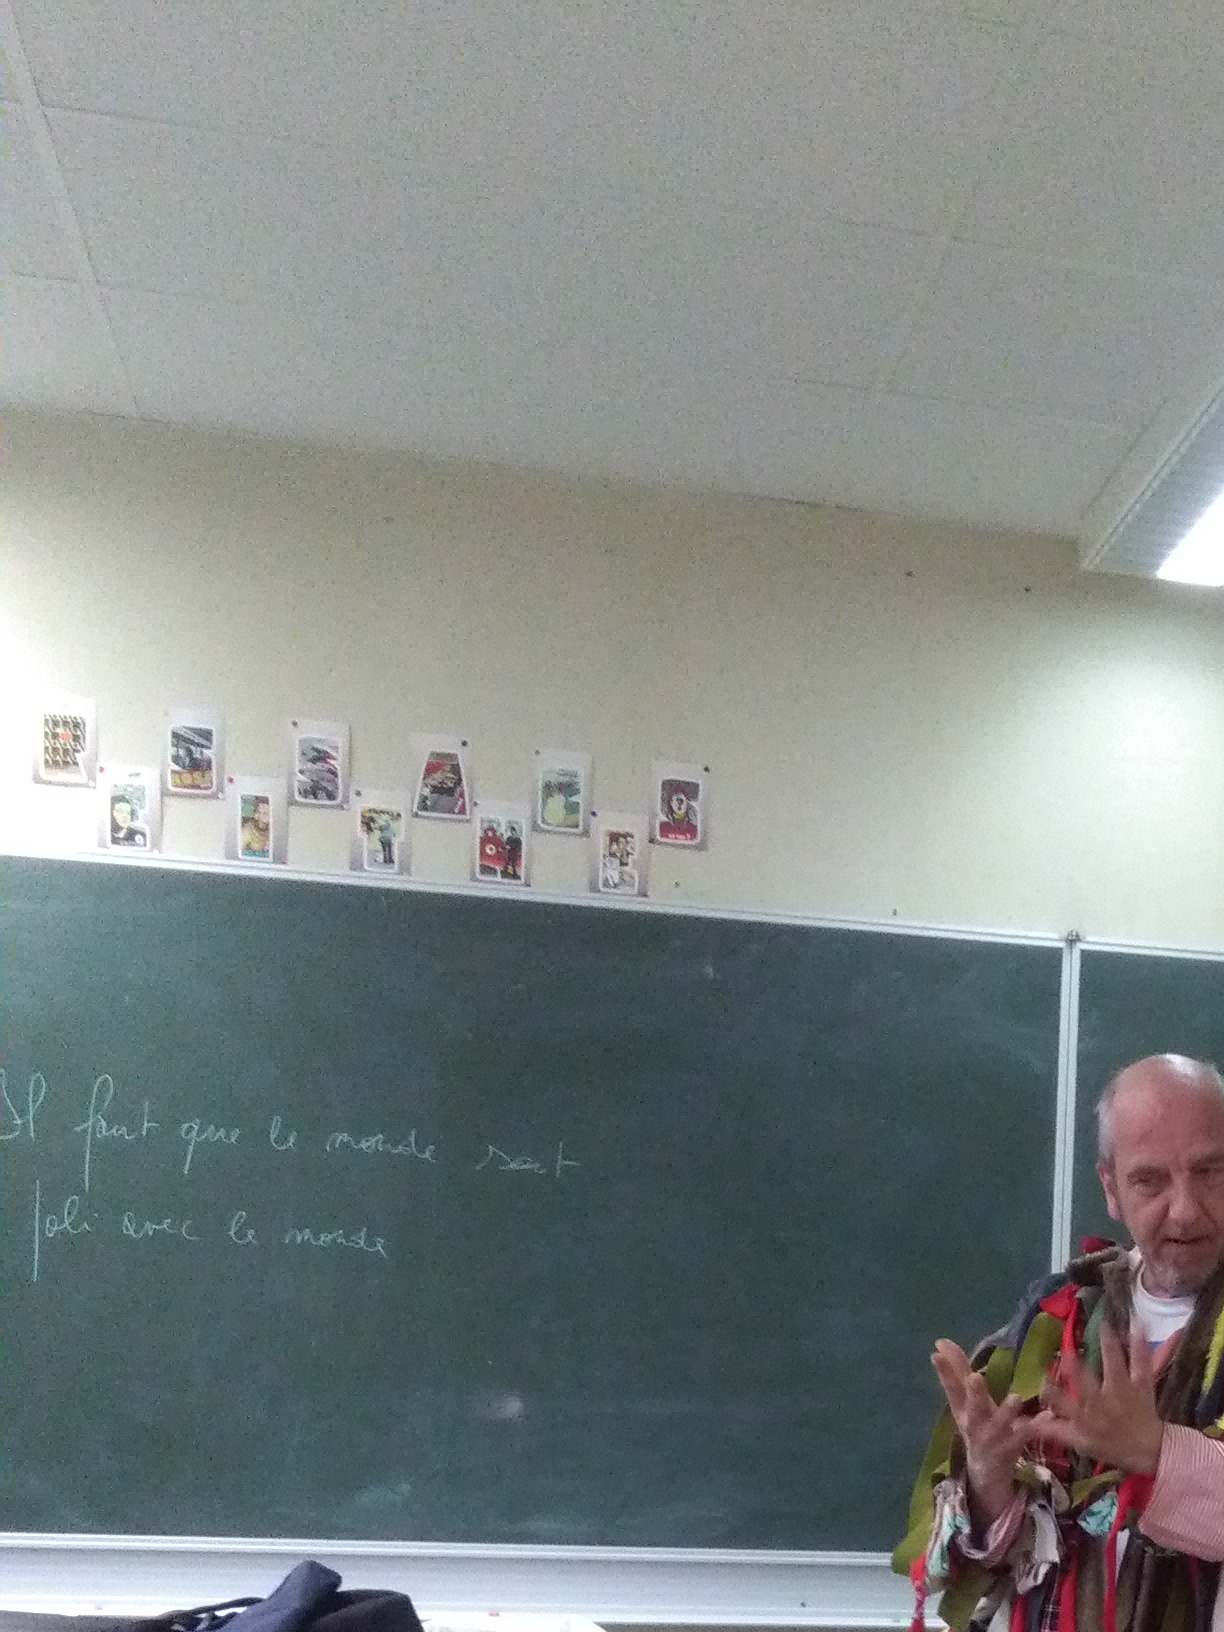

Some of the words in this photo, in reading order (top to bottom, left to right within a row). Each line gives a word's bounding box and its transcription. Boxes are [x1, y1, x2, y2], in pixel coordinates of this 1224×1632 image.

[74, 1073, 160, 1192] faut
[180, 1117, 242, 1174] que
[269, 1114, 298, 1151] le
[325, 1127, 437, 1163] monde
[122, 1211, 201, 1240] avec
[228, 1211, 259, 1244] le
[284, 1226, 389, 1259] monde
